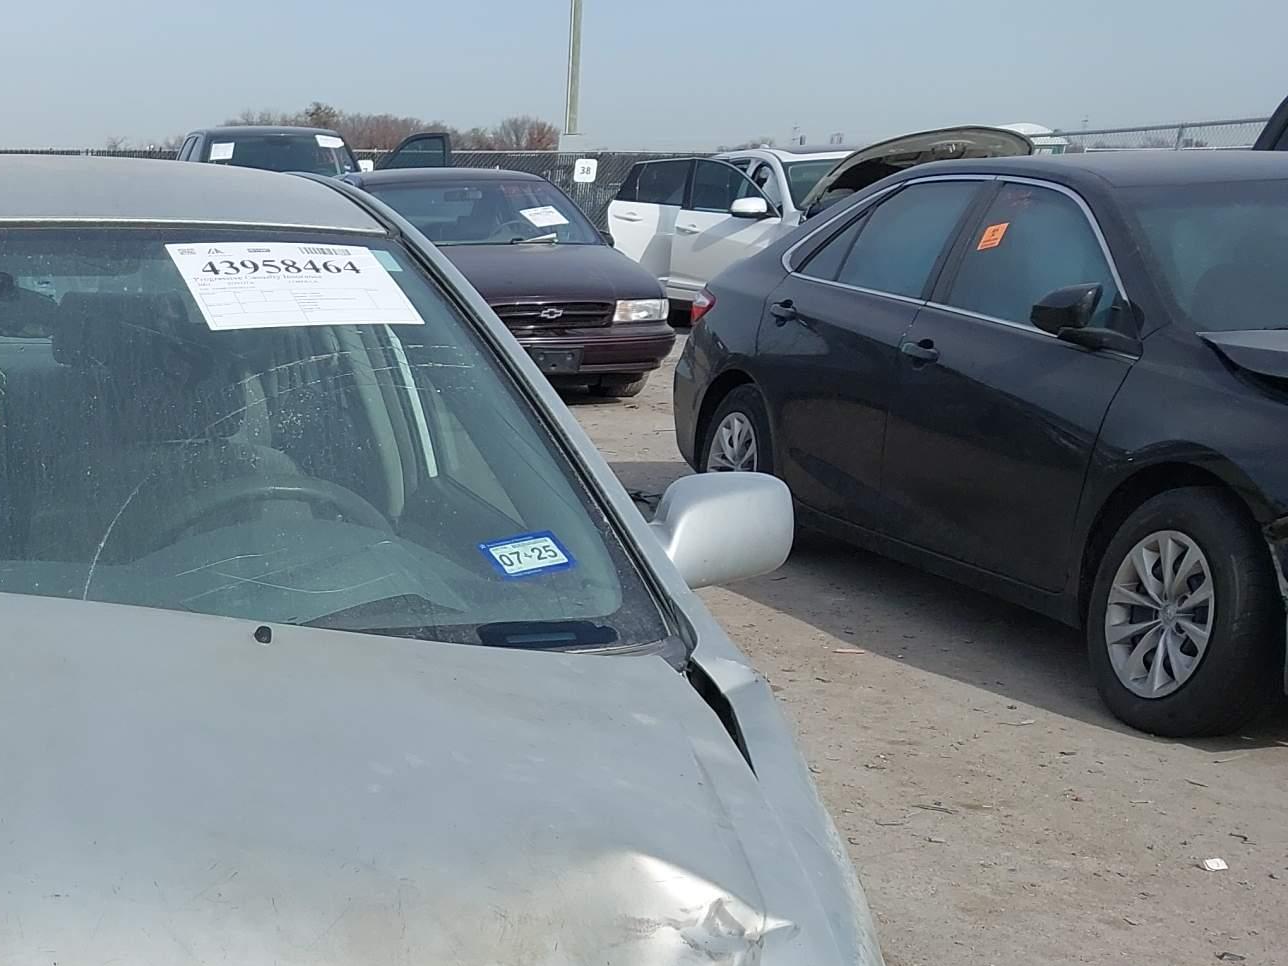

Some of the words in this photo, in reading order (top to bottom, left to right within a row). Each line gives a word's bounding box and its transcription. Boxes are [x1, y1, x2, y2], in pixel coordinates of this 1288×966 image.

[579, 166, 592, 175] 38
[202, 259, 361, 275] 43958464
[498, 551, 523, 567] 07
[531, 545, 558, 561] 25
